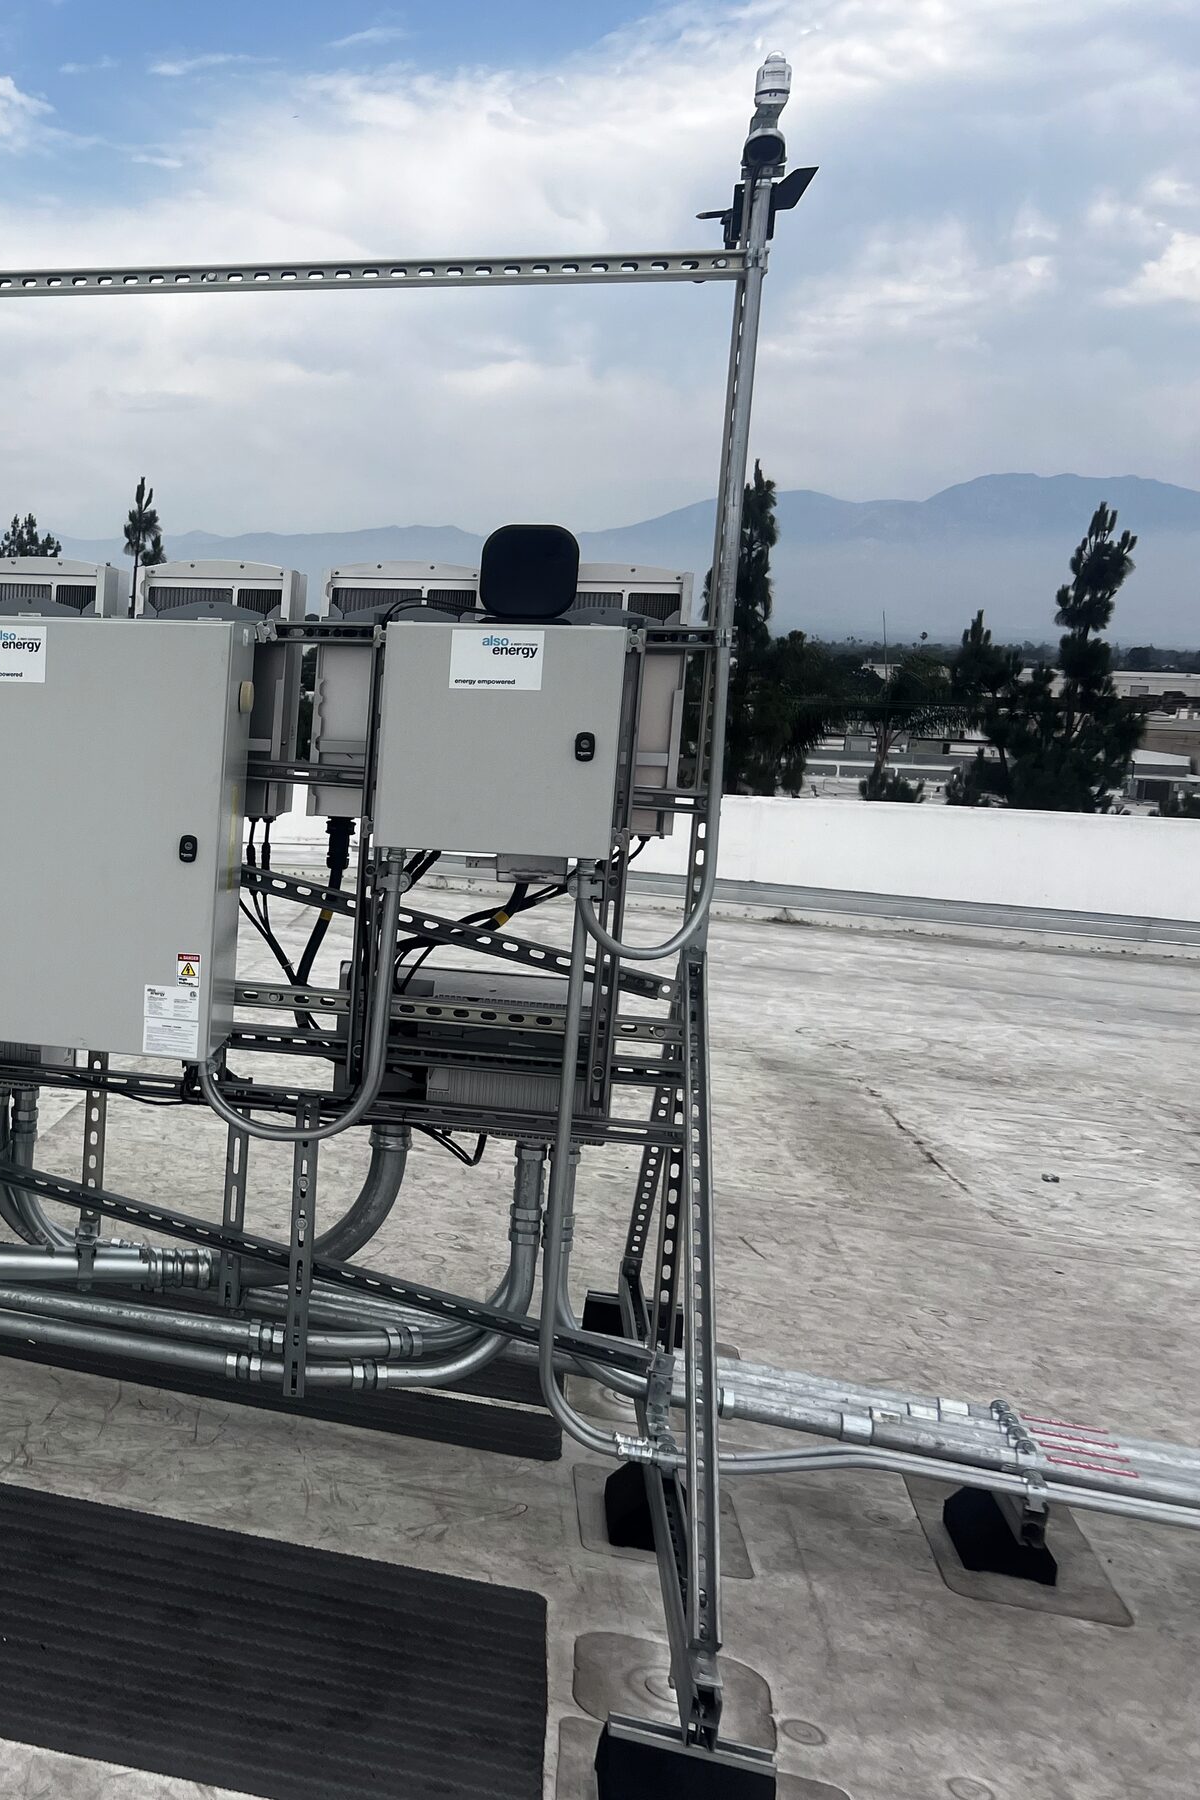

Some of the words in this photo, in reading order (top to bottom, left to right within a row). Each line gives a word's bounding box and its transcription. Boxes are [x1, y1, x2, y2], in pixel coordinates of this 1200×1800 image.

[482, 635, 509, 646] also
[2, 641, 41, 652] energy
[492, 646, 539, 659] energy
